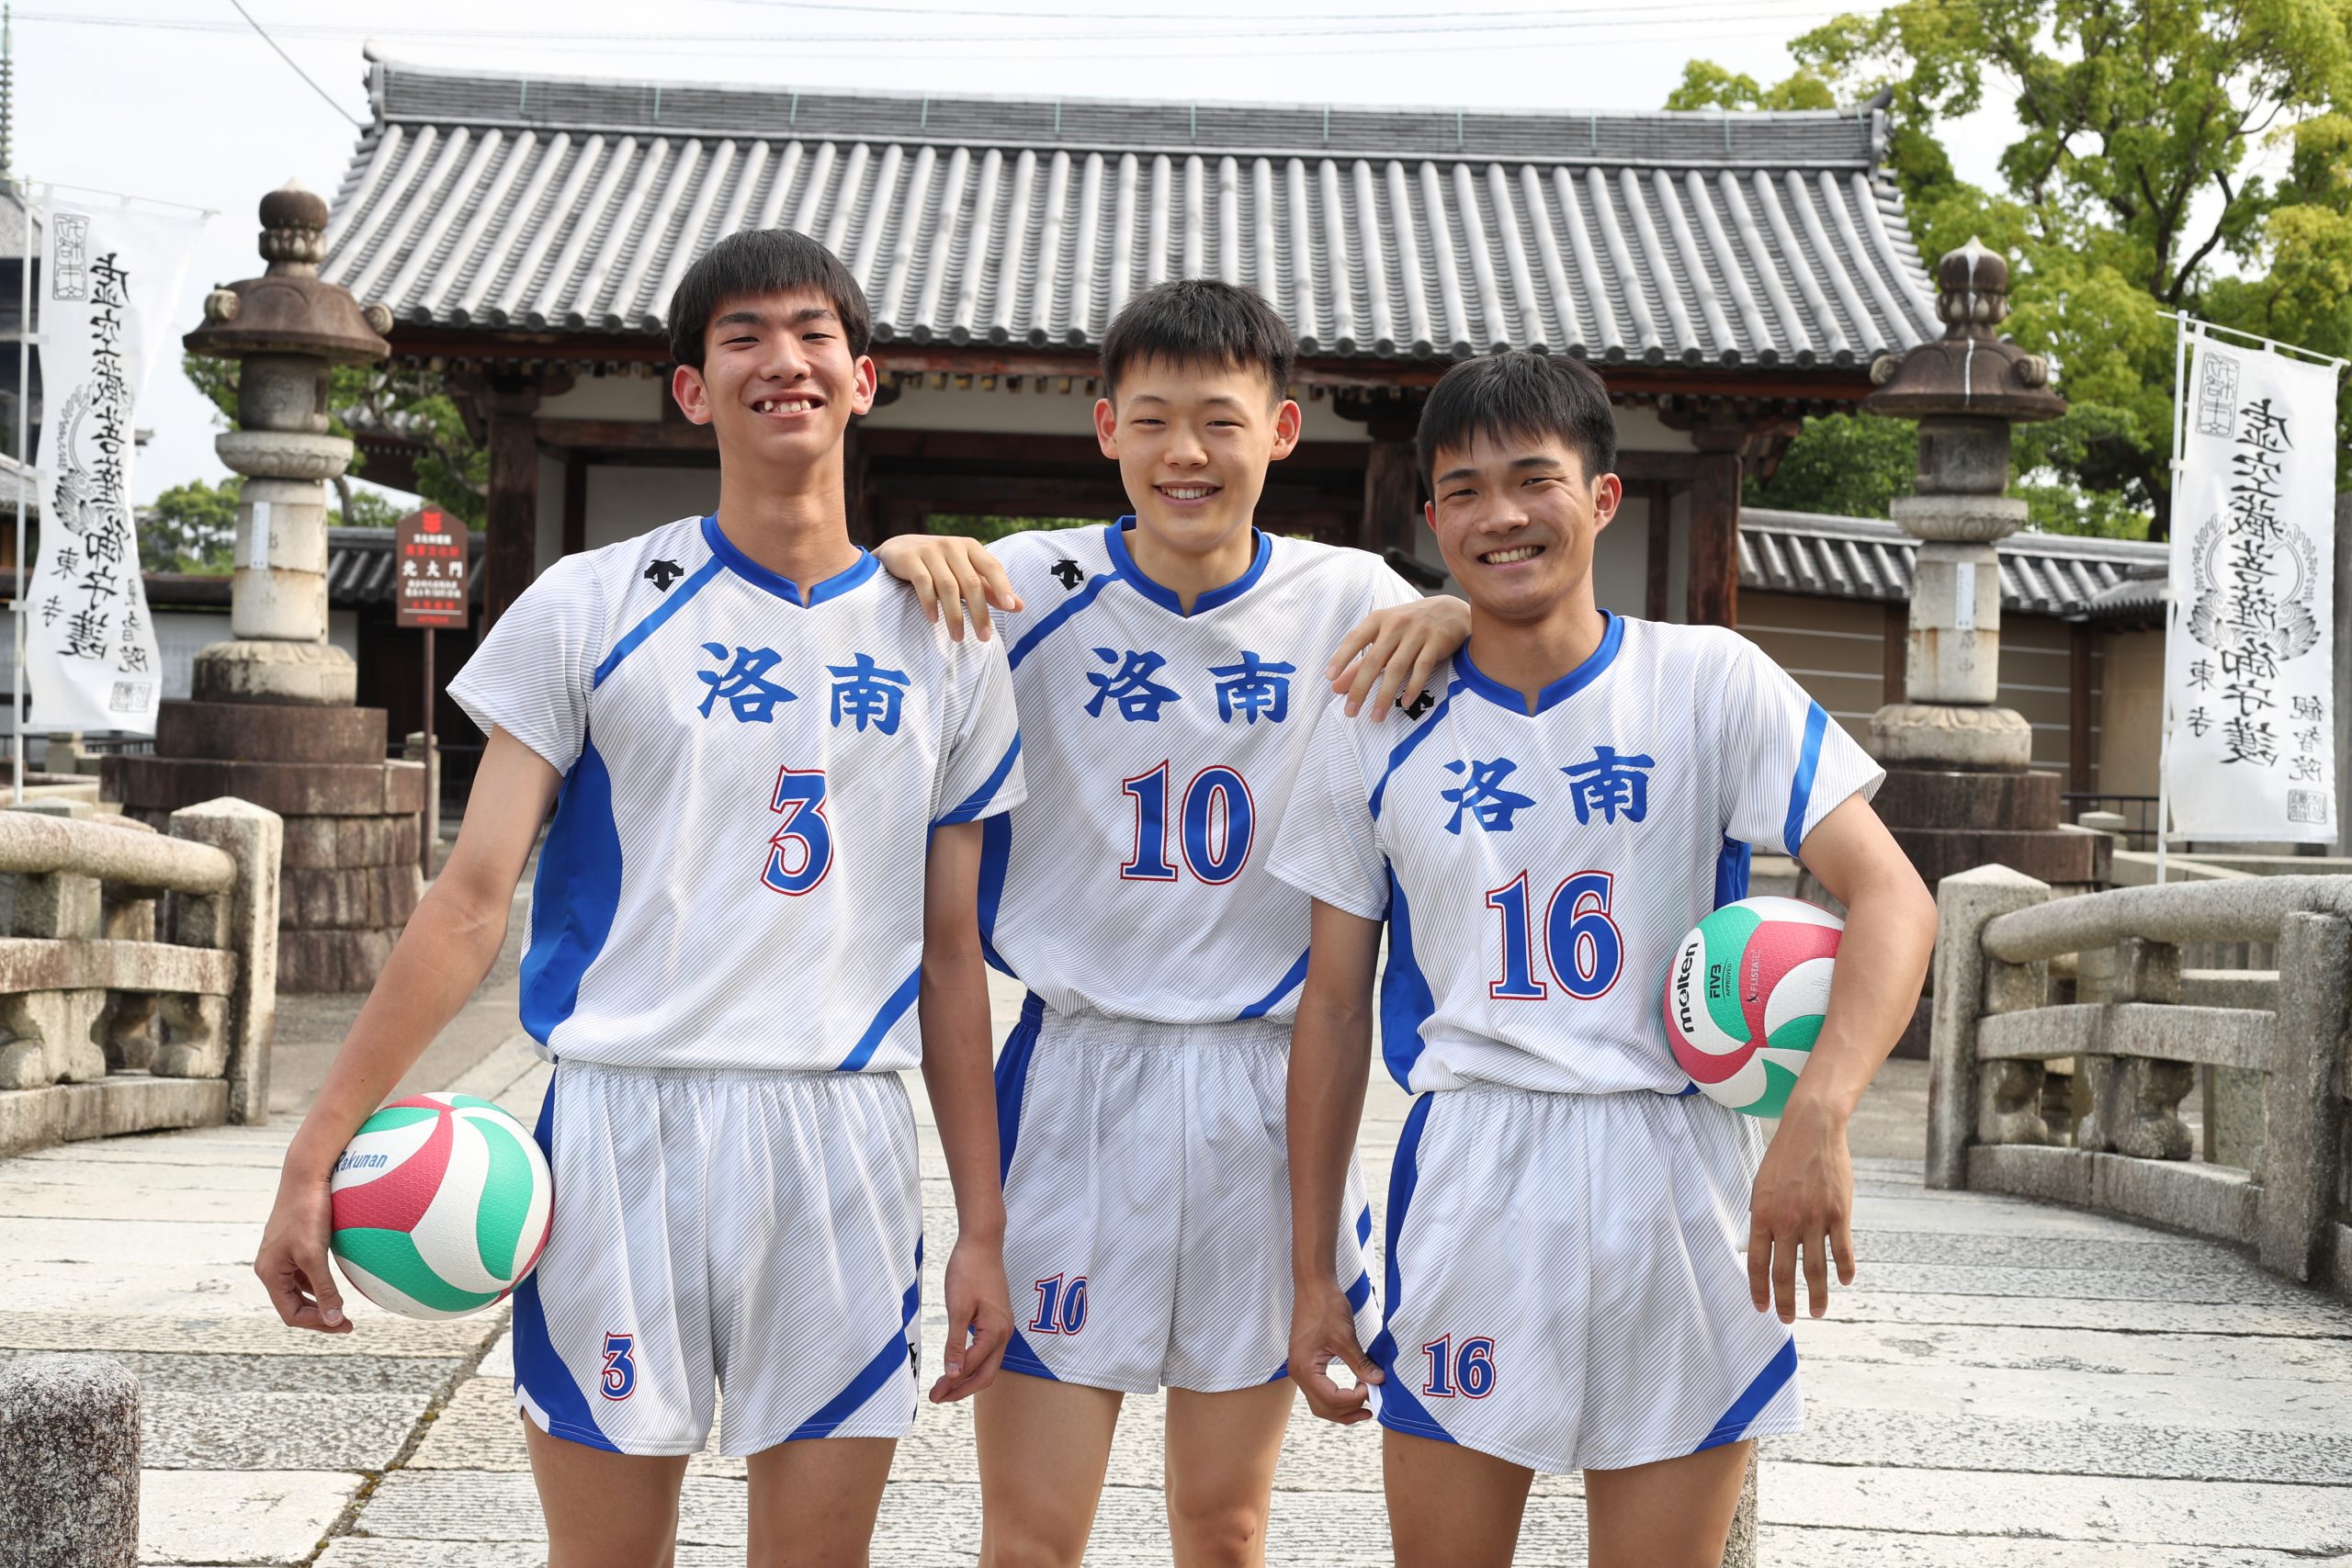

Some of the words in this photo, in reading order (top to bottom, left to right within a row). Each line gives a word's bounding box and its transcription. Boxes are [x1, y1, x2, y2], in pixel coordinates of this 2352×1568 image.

[401, 559, 463, 579] 北大門
[696, 641, 911, 736] 洛南
[1083, 647, 1297, 726] 洛南
[1120, 759, 1256, 886] 10
[1441, 746, 1656, 835] 洛南
[761, 764, 834, 897] 3
[1486, 868, 1624, 1000] 16
[1676, 942, 1699, 1033] molten
[1709, 964, 1723, 999] FIVB
[1724, 963, 1733, 998] APPROVED
[334, 1149, 389, 1173] Rakunan
[1028, 1272, 1088, 1337] 10
[599, 1330, 637, 1402] 3
[1421, 1333, 1497, 1400] 16
